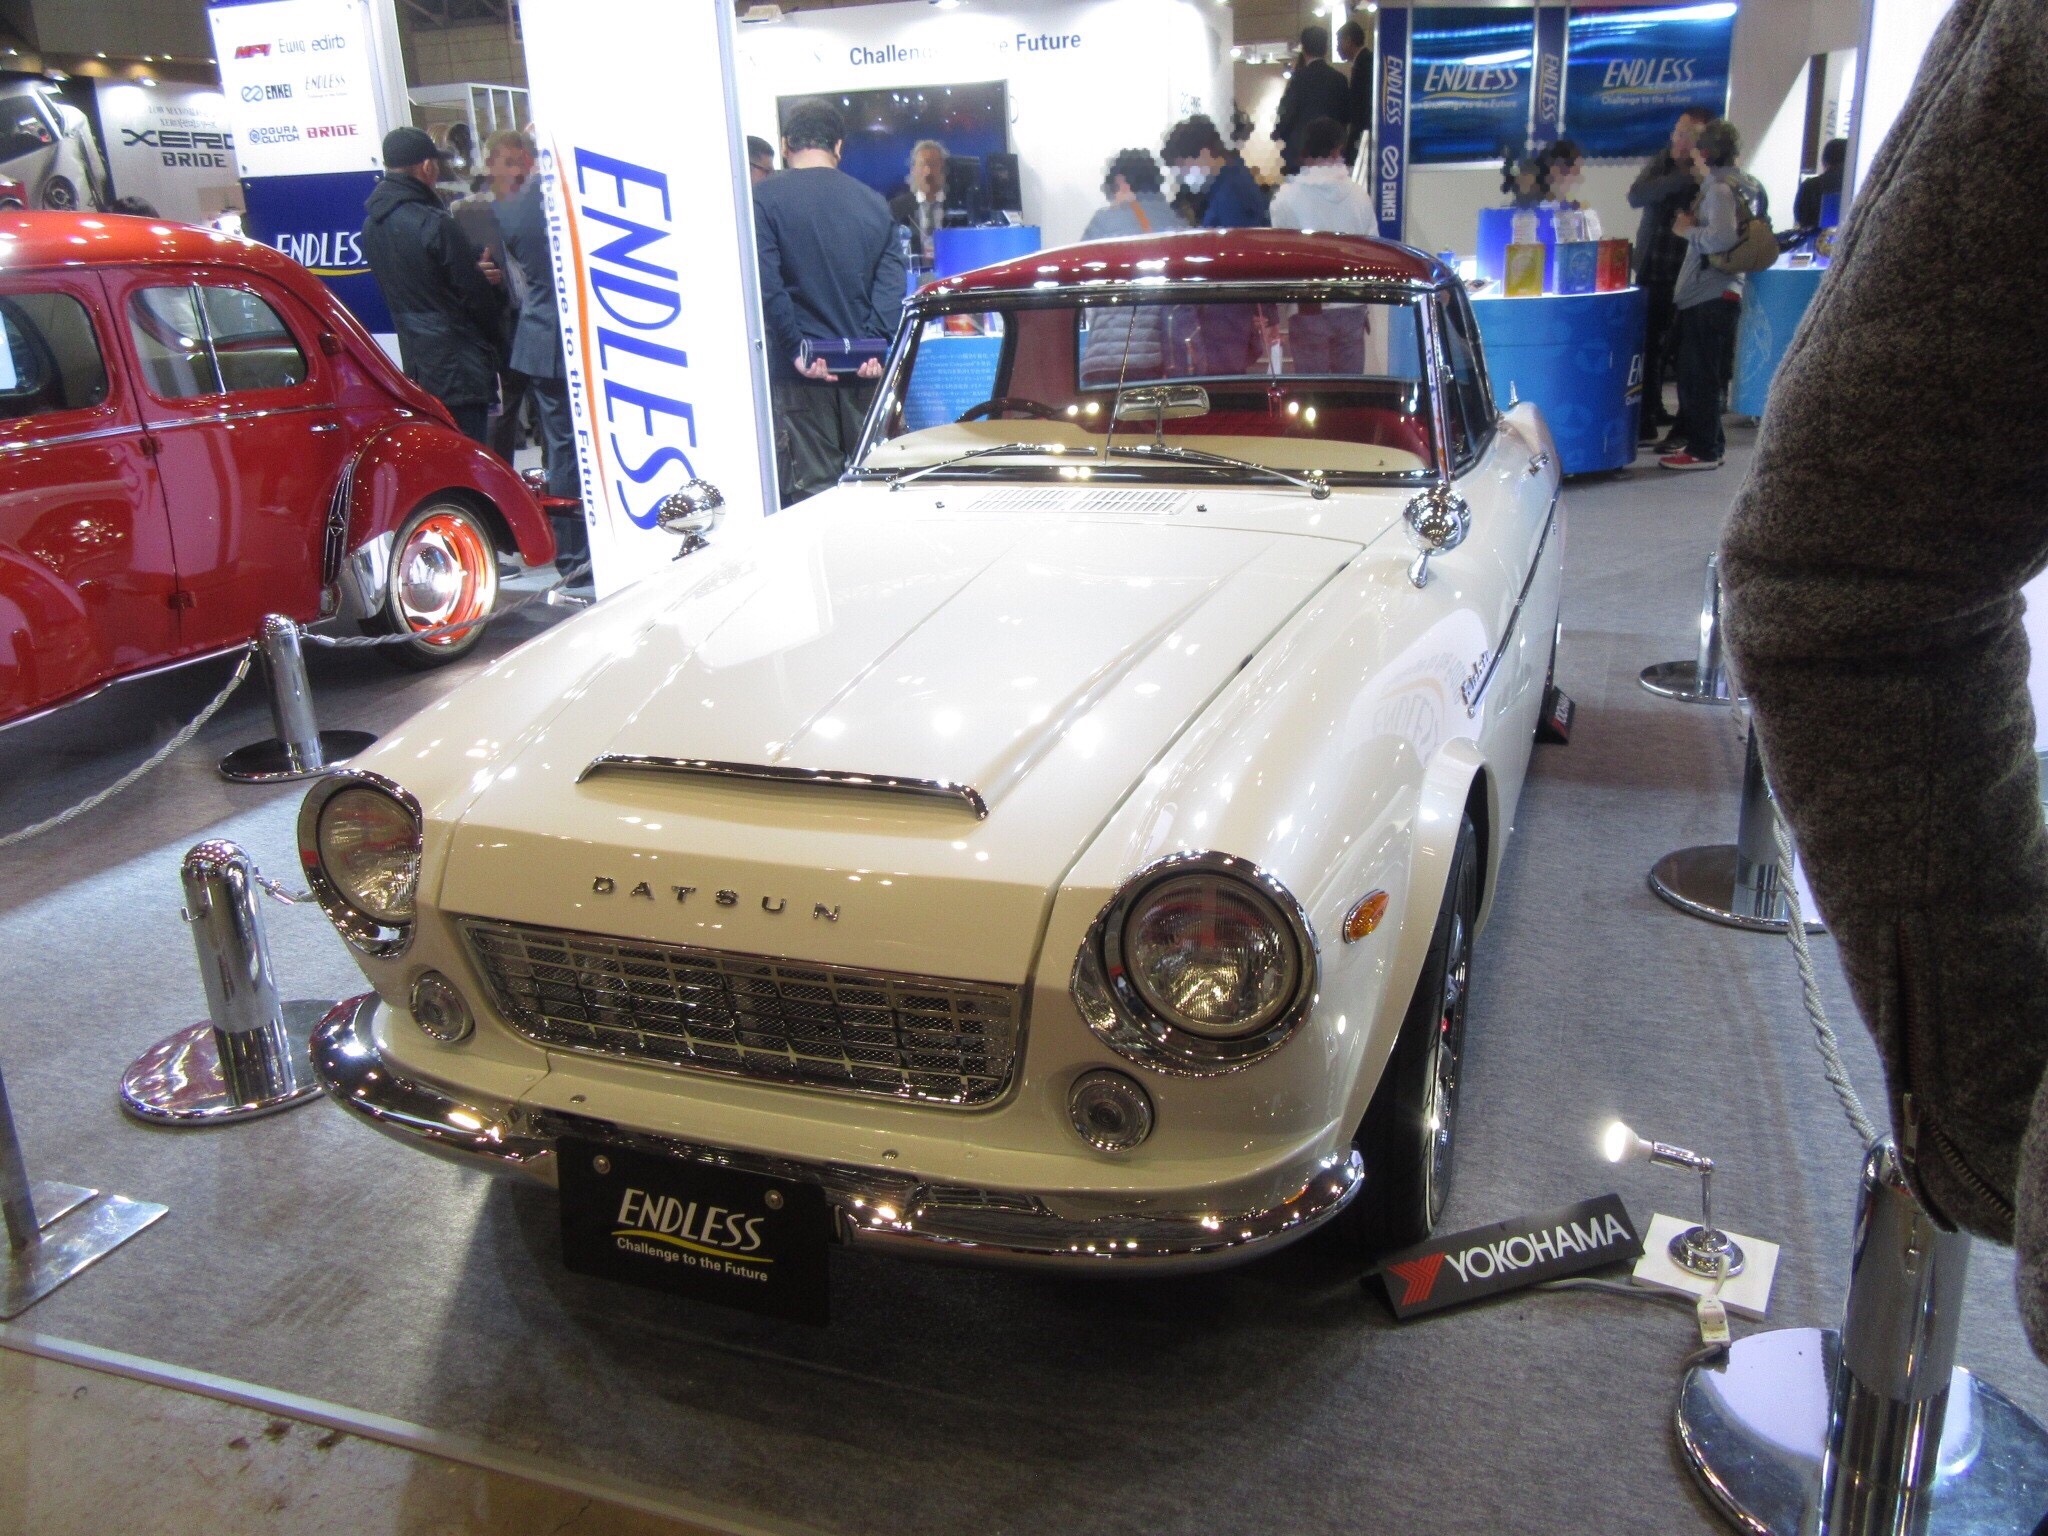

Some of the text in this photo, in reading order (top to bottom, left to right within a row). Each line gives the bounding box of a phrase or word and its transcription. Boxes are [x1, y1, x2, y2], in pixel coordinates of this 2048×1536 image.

[1015, 33, 1082, 52] Future
[265, 83, 293, 100] ENKEI
[1385, 54, 1403, 126] ENDLESS
[1423, 62, 1519, 93] ENDLESS
[1541, 53, 1560, 122] ENDLESS
[1602, 57, 1698, 89] ENDLESS
[260, 125, 299, 136] OGURA
[261, 132, 300, 144] CLUTCH
[306, 124, 359, 139] BRIDE
[161, 151, 228, 168] BRIDE
[1381, 181, 1397, 222] ENKEI
[276, 231, 369, 268] ENDLES
[564, 325, 575, 357] to
[570, 367, 583, 418] the
[577, 429, 597, 527] Future
[592, 875, 842, 923] DATSUN
[617, 1187, 765, 1251] ENDLESS
[616, 1236, 769, 1282] Challenge to the Future
[1444, 1213, 1631, 1283] YOKOHAMA
